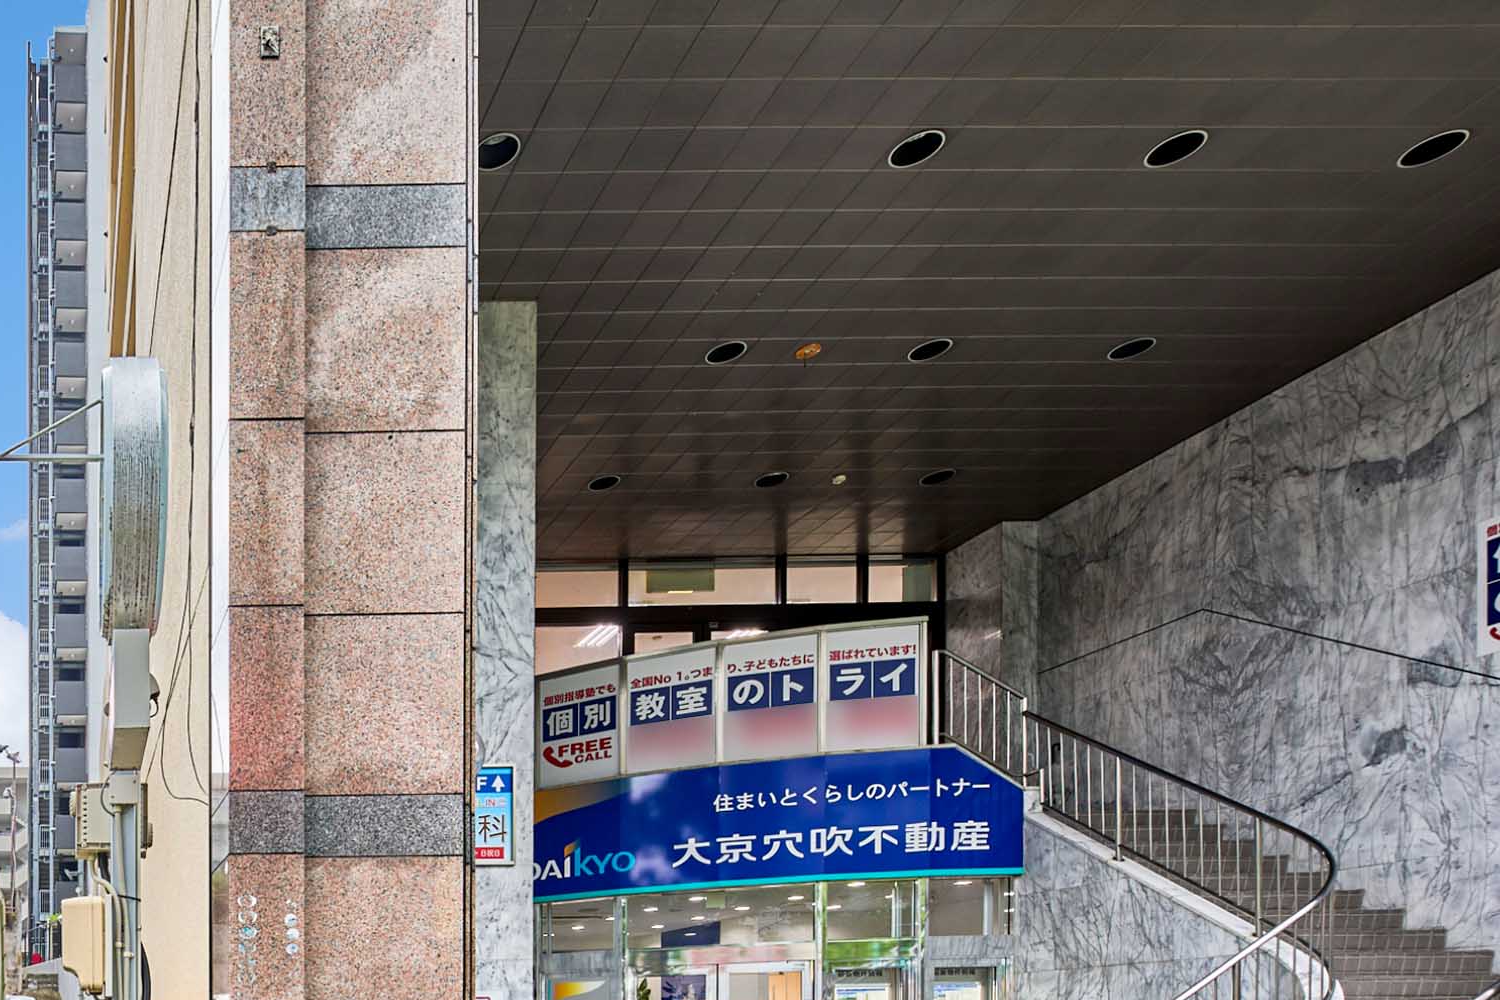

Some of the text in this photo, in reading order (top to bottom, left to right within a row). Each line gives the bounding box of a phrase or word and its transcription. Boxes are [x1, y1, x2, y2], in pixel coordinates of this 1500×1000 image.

[558, 737, 612, 758] FREE
[574, 750, 612, 764] CALL
[713, 777, 991, 812] 住まいとくらしのパートナー
[671, 820, 991, 869] 大京穴吹不動産
